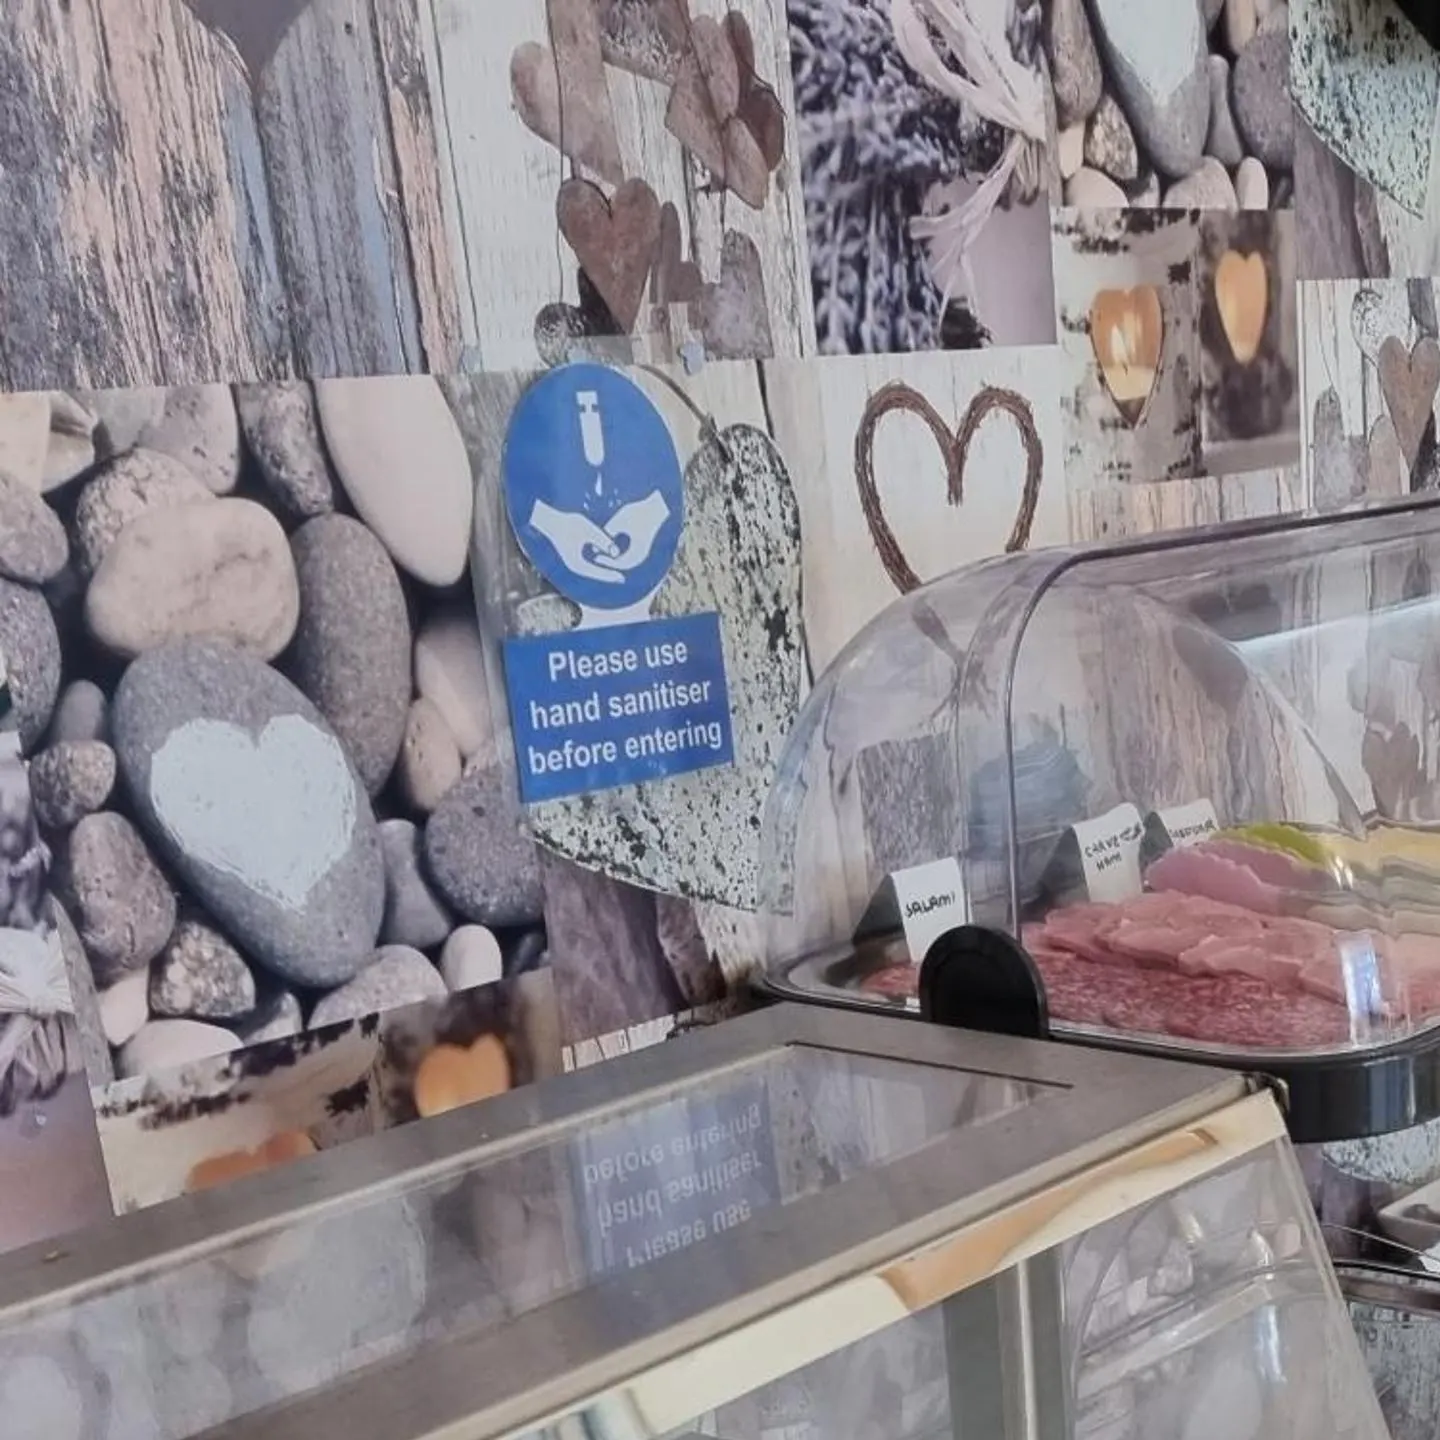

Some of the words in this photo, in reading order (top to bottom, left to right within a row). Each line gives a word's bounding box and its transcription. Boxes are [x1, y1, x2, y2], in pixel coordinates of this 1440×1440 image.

[548, 646, 638, 681] Please
[645, 640, 688, 669] use
[530, 692, 600, 730] hand
[608, 677, 711, 716] sanitiser
[529, 739, 617, 775] before
[625, 721, 722, 760] entering
[905, 890, 956, 918] SALAMI
